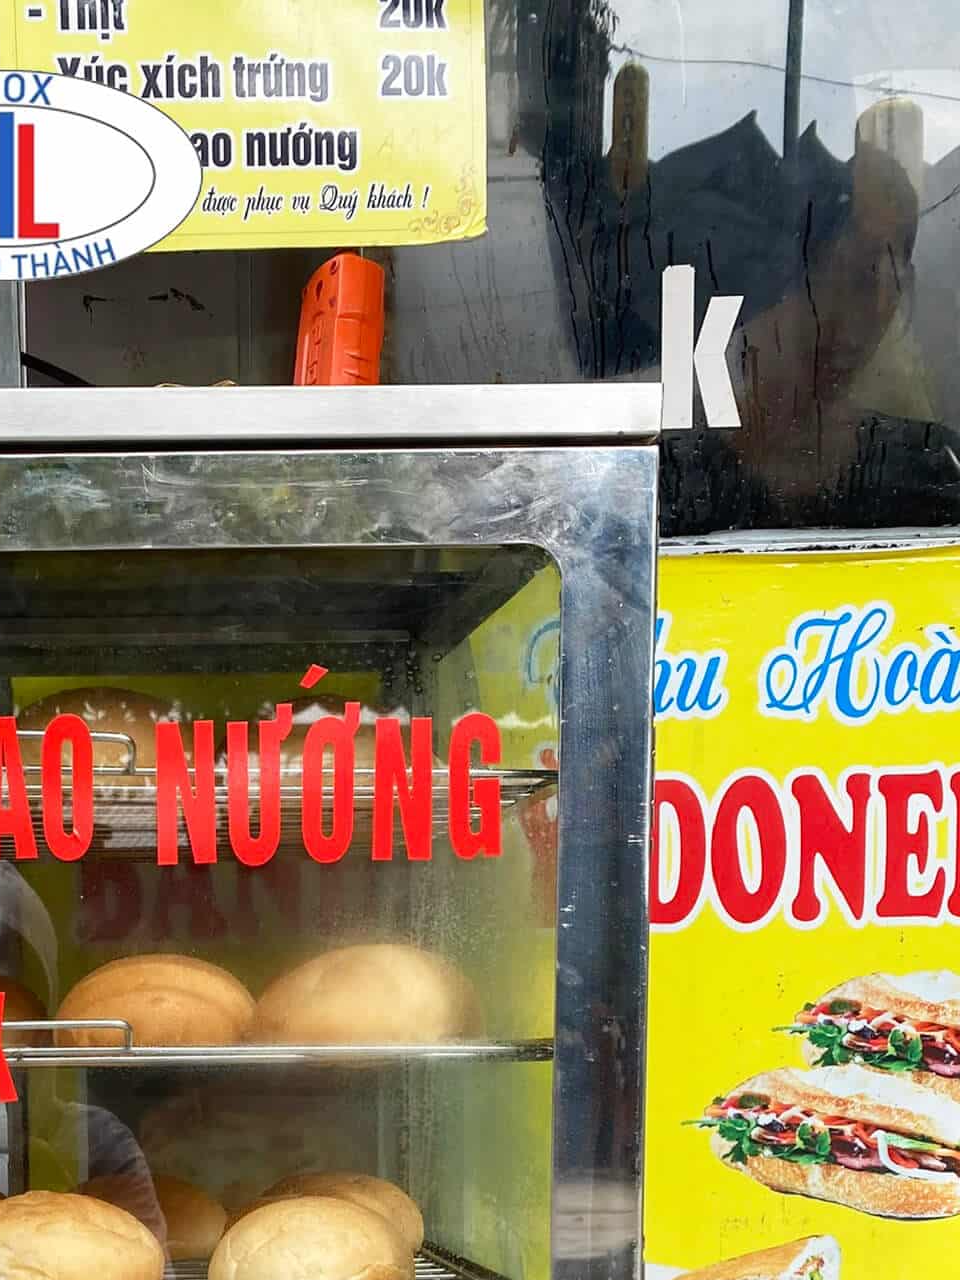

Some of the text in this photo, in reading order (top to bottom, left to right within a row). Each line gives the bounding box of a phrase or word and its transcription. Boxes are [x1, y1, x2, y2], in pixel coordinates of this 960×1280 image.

[141, 55, 220, 98] xích
[233, 53, 329, 102] trứng
[381, 55, 447, 96] 20k
[246, 122, 357, 171] nướng
[202, 186, 238, 216] được
[243, 185, 283, 221] phục
[320, 185, 359, 220] Quý
[366, 183, 414, 210] khách
[155, 665, 502, 867] NƯỚNG
[650, 770, 960, 924] DONE
